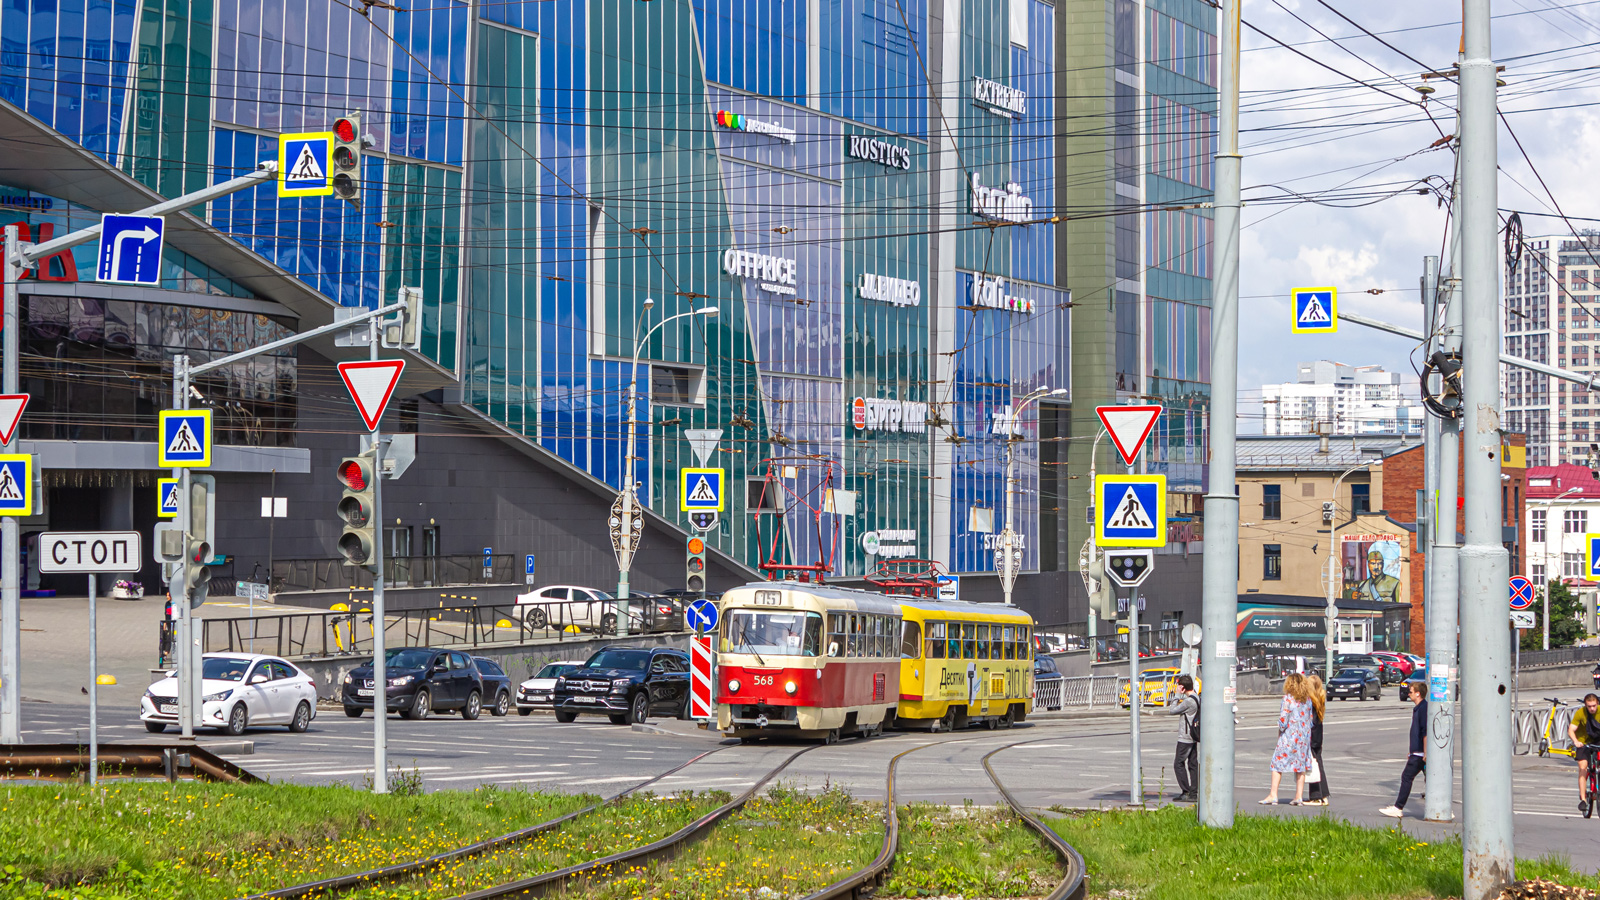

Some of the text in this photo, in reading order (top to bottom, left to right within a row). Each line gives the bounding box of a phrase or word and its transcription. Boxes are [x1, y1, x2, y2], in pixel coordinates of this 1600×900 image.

[975, 76, 1026, 114] EXTREME
[850, 136, 910, 170] ROSTIC'S
[725, 248, 797, 285] OFFPRICE
[865, 397, 927, 433] БУРГЕР КИНГ
[52, 540, 127, 565] СТОП
[1253, 619, 1282, 627] СТАРТ
[754, 675, 773, 686] 568
[940, 668, 965, 689] Десятки
